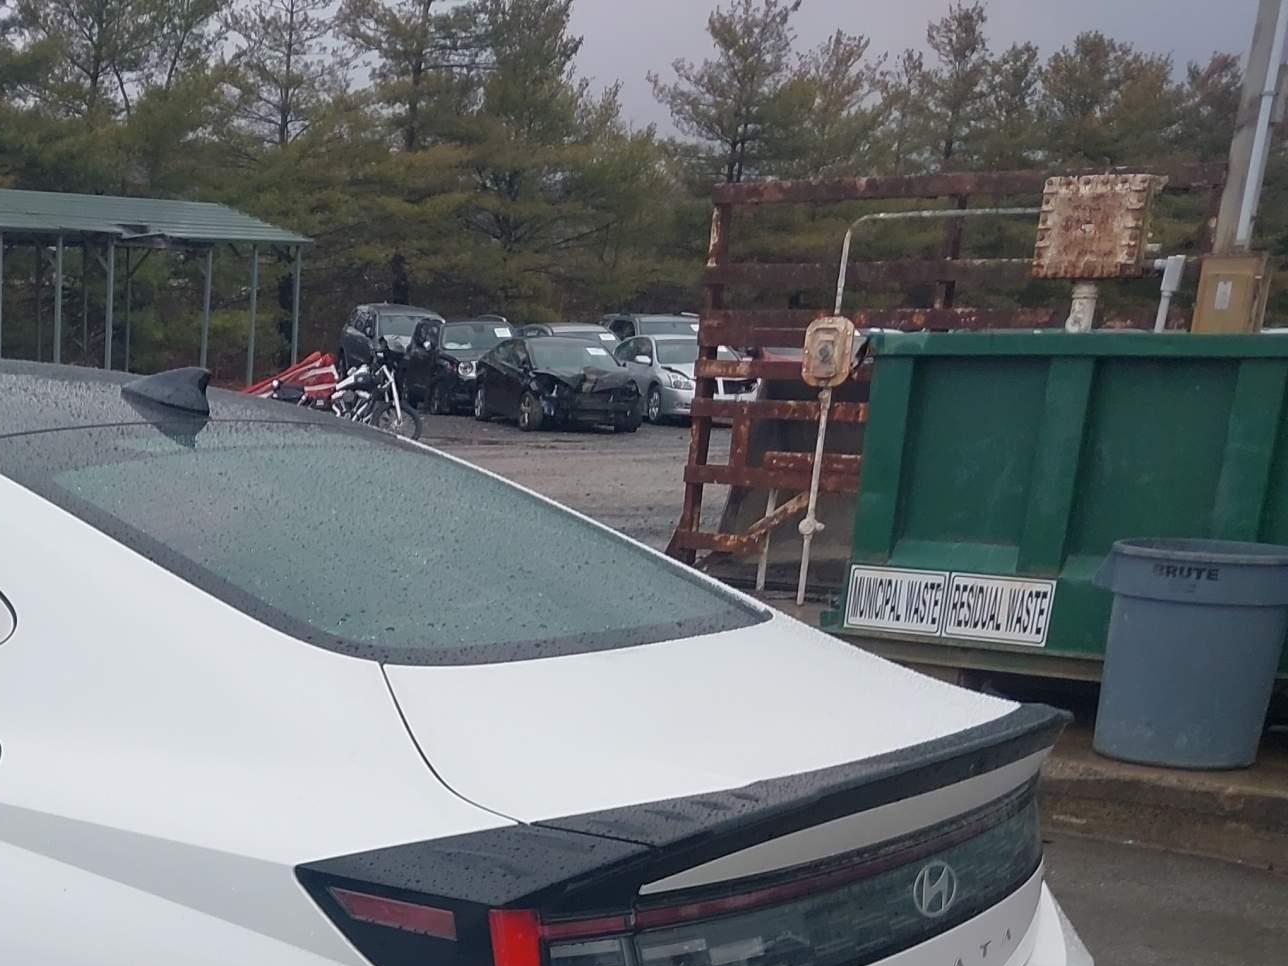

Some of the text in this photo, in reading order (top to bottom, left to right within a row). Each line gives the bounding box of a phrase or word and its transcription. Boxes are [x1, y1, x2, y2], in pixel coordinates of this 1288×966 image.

[1153, 564, 1220, 582] BRUTE
[850, 576, 942, 626] MUNICIPAL WASTE
[948, 583, 1049, 636] RESIDUAL WASTE
